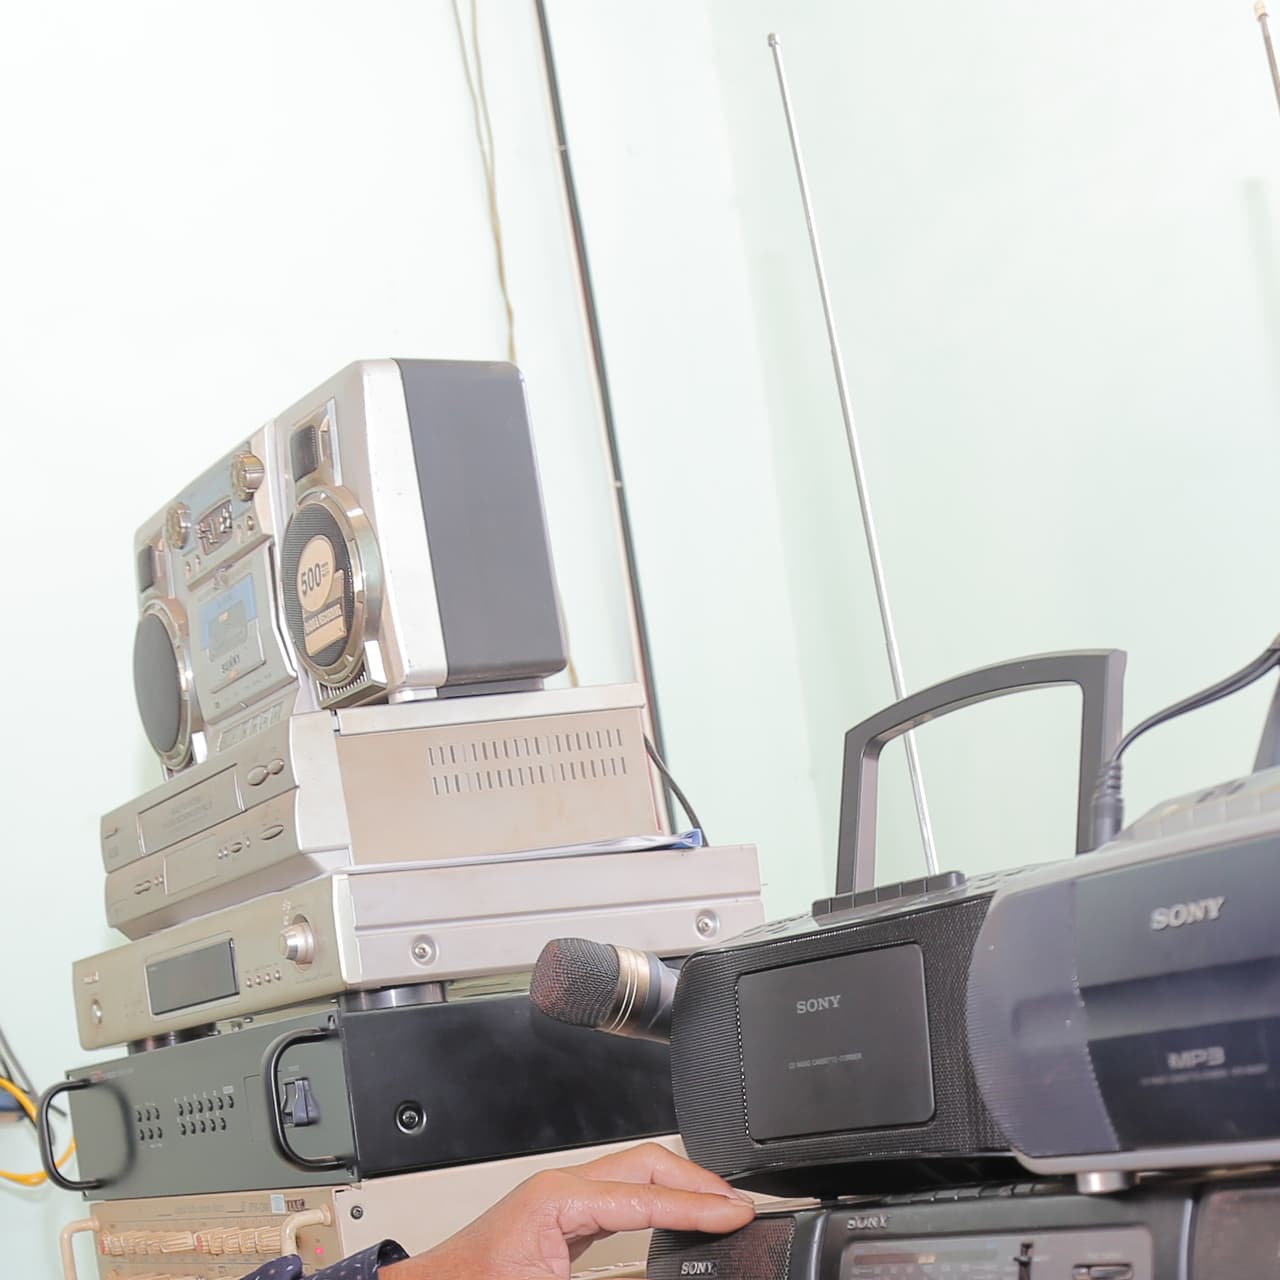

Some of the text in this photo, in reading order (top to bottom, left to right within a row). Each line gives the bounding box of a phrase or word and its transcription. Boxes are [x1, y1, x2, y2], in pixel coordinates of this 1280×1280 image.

[301, 562, 322, 597] 500
[1150, 896, 1225, 931] SONY
[796, 994, 841, 1014] SONY
[1167, 1046, 1225, 1070] MP3
[847, 1215, 889, 1230] SONY
[681, 1262, 714, 1276] SONY
